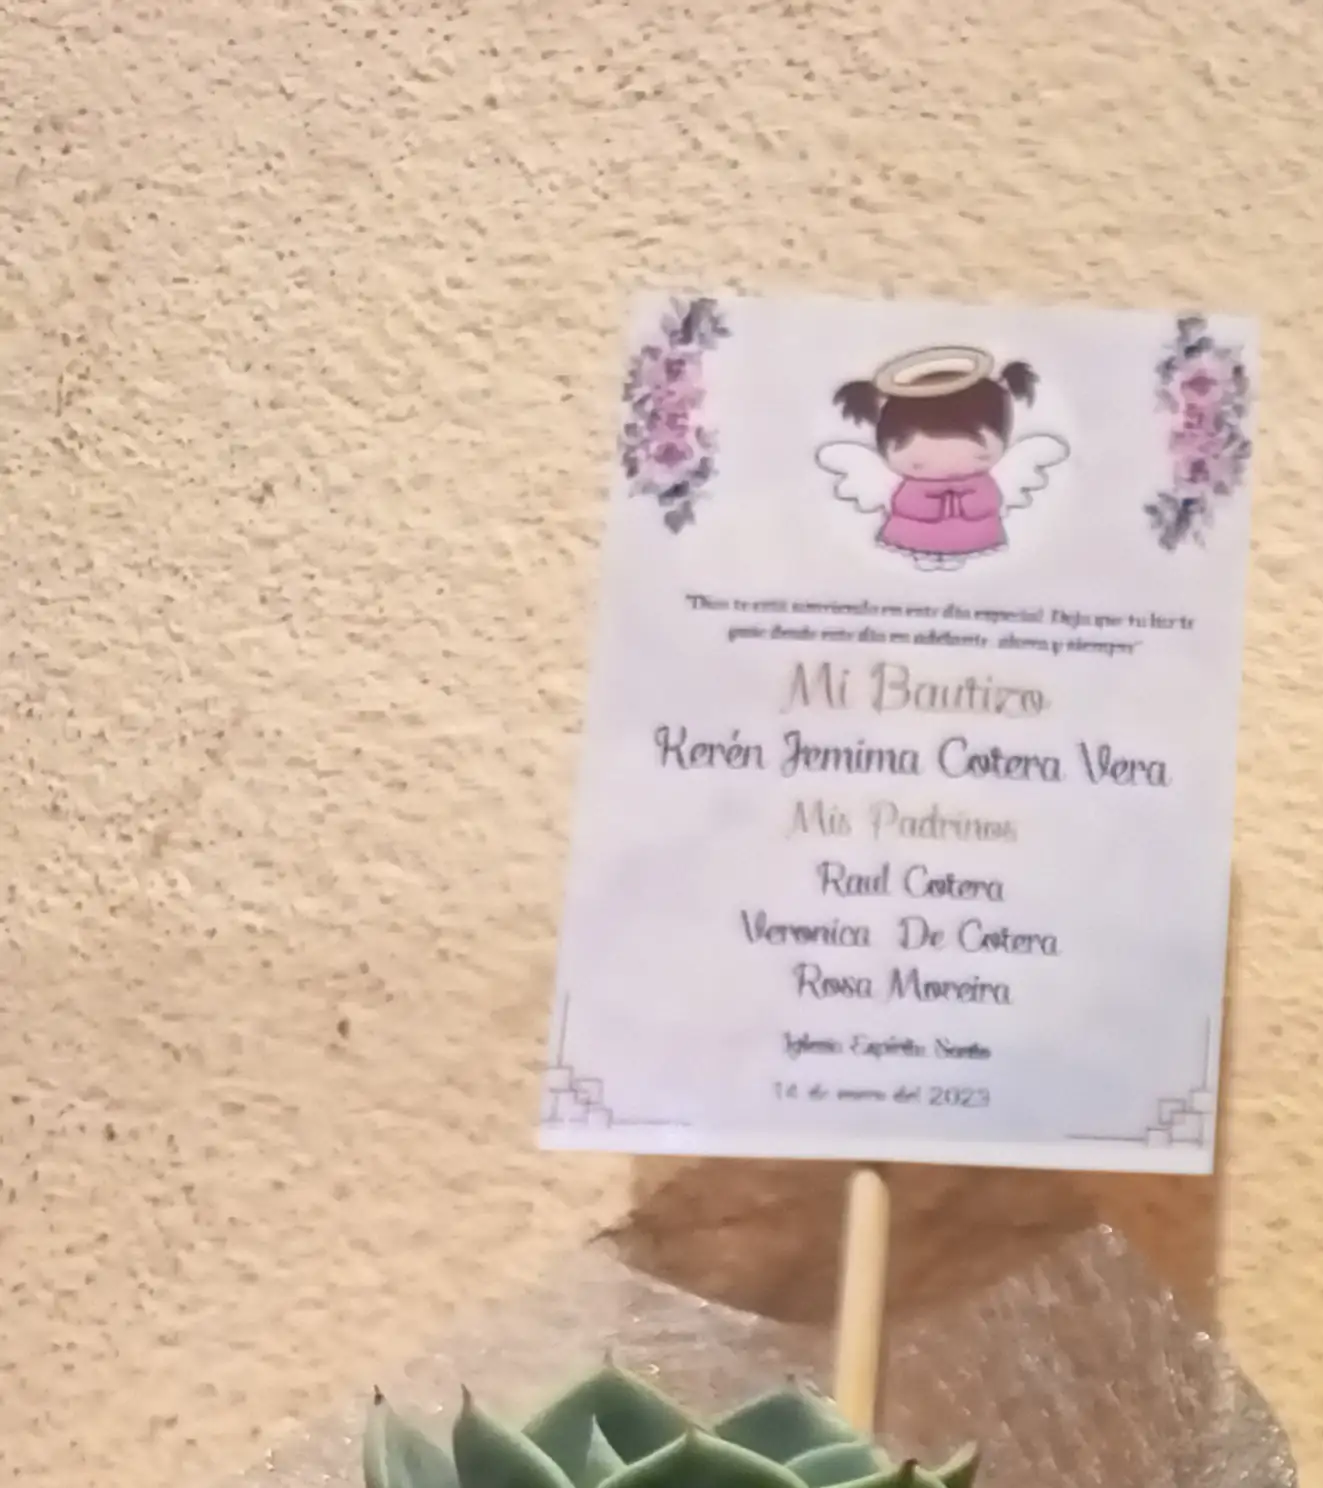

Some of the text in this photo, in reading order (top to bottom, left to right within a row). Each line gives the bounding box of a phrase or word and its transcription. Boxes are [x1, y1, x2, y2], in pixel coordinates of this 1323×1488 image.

[779, 660, 1052, 716] Mi Bautizo
[654, 726, 1173, 788] Kerén Jemima Cotera Vera
[785, 798, 1018, 843] Mis Padrinos
[816, 861, 1004, 902] Raul Cotera
[741, 910, 1060, 956] Veronica De Cotera
[793, 963, 1012, 1005] Rosa Moreira
